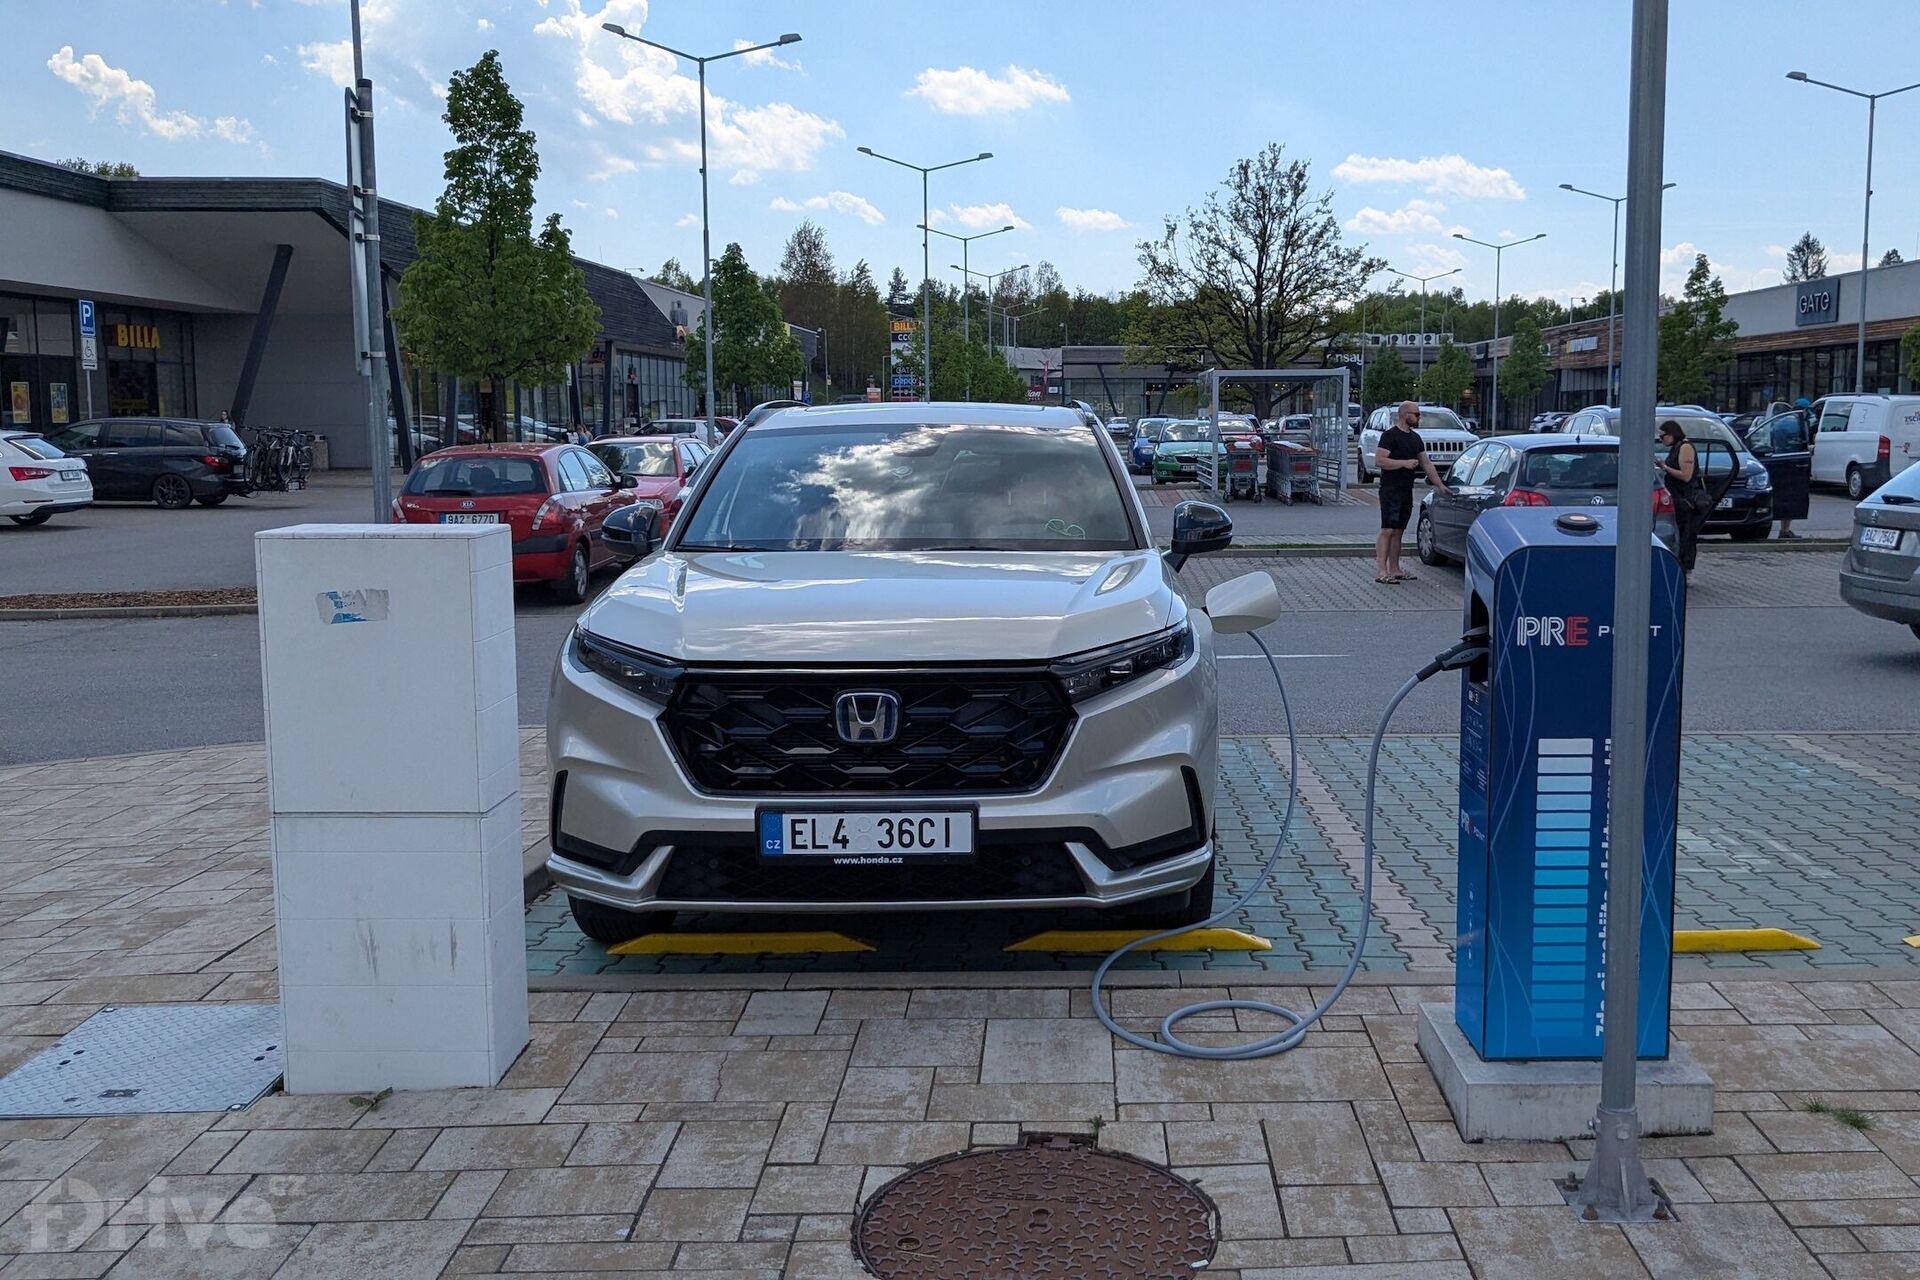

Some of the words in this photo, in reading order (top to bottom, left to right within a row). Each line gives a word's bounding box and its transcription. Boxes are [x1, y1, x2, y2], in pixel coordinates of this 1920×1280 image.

[82, 304, 92, 325] P
[893, 321, 917, 331] BILL
[117, 324, 160, 348] BILLA
[472, 515, 495, 524] 6770
[1517, 616, 1590, 647] PRE
[790, 818, 849, 850] EL4
[877, 817, 950, 849] 36CI
[766, 839, 781, 850] CZ
[833, 855, 904, 865] www.honda.cz
